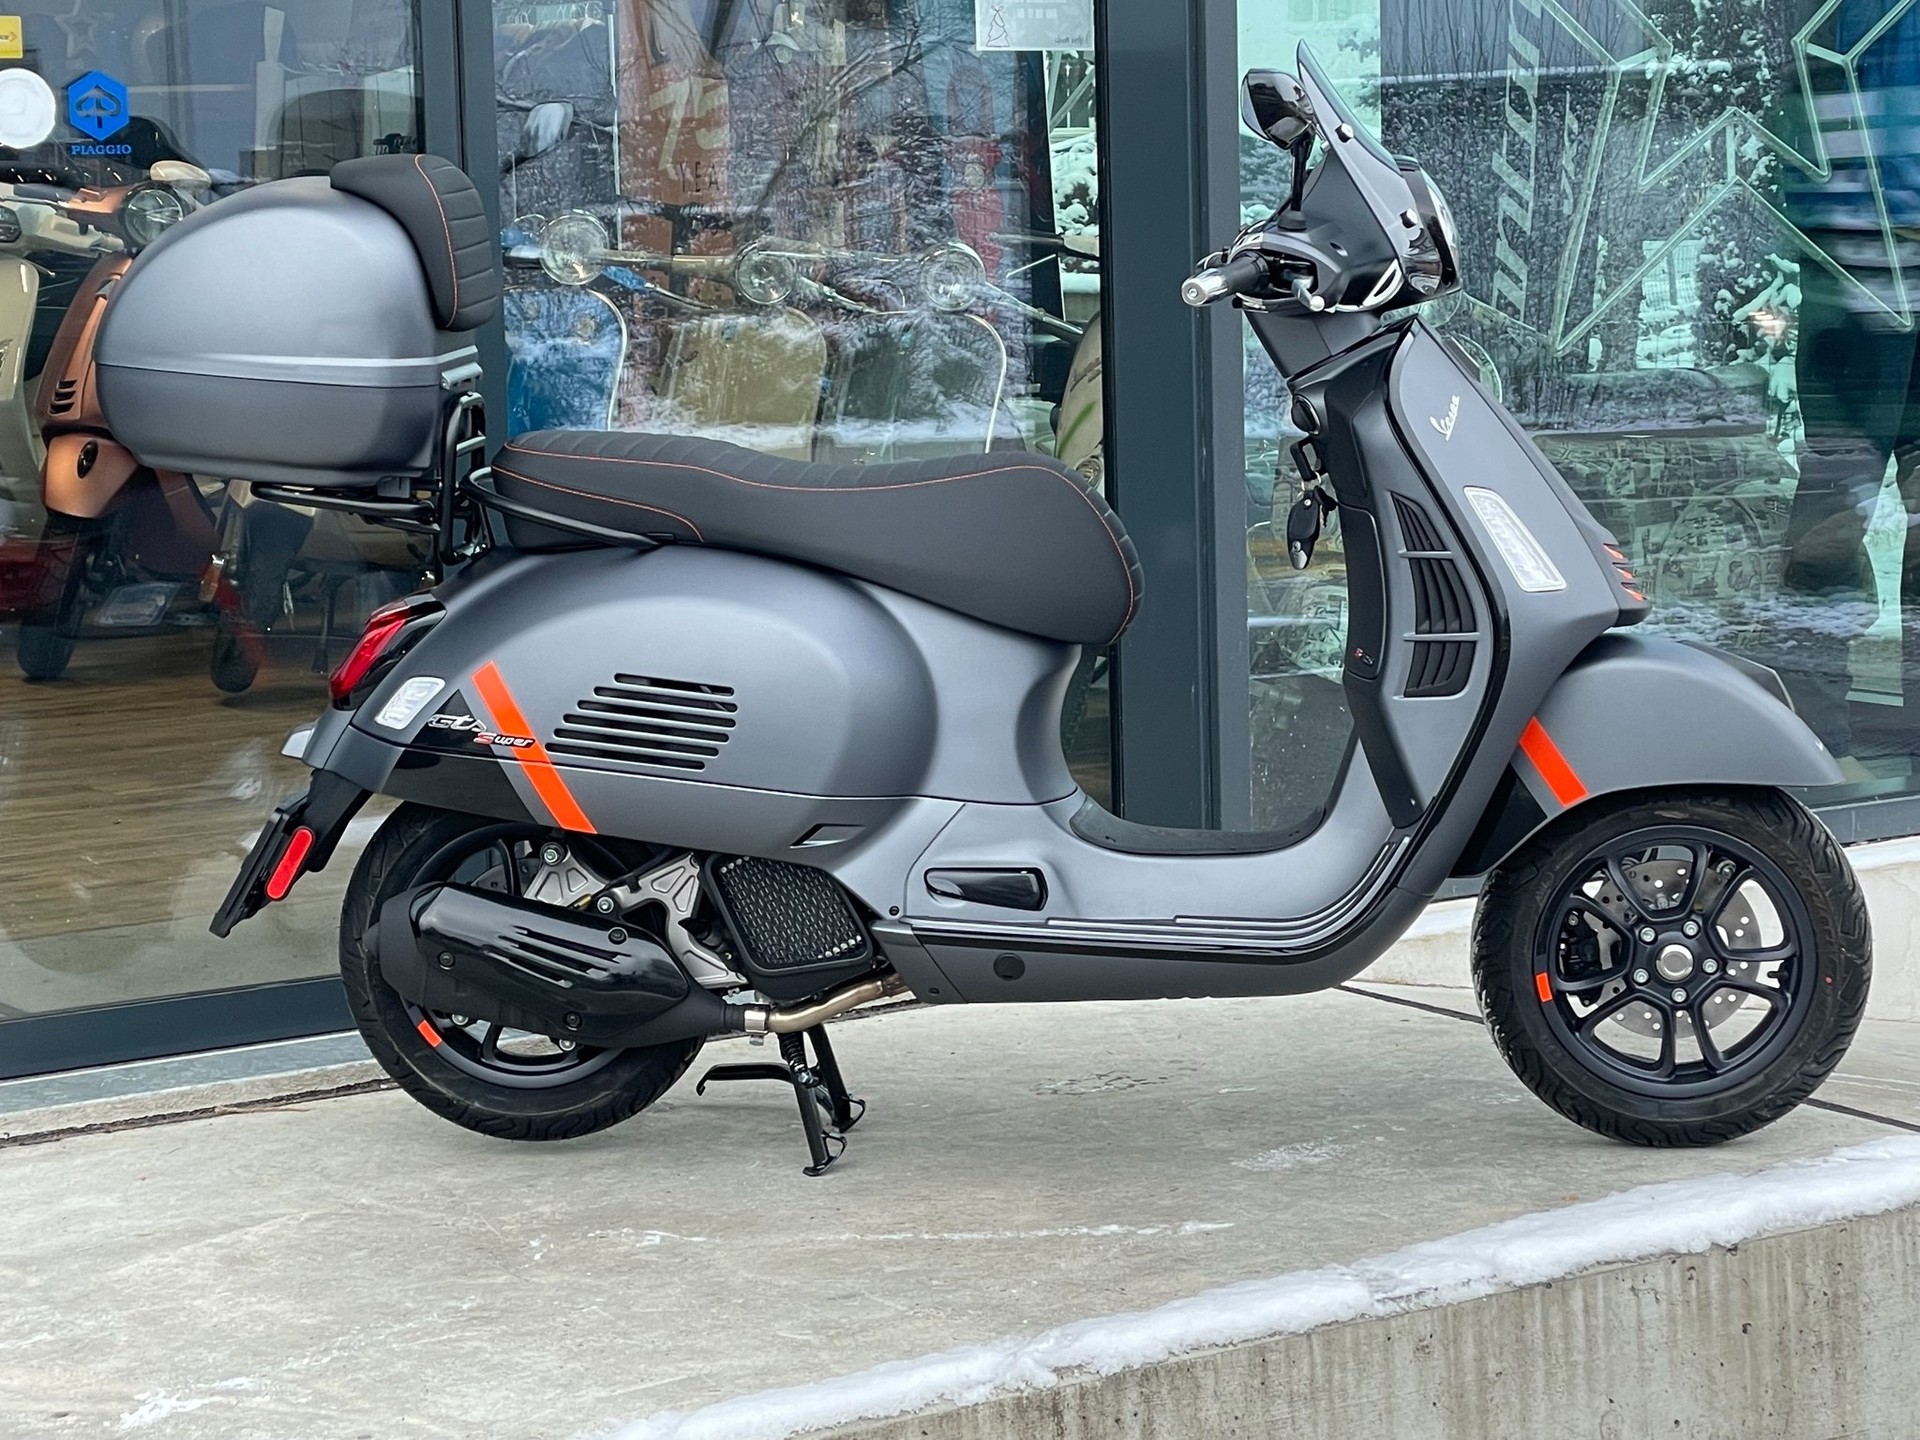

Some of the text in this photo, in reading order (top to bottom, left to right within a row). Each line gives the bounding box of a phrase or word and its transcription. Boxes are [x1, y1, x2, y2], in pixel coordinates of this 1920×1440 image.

[70, 143, 133, 156] PIAGGIO
[1429, 394, 1460, 442] Vespa
[472, 731, 535, 748] Super
